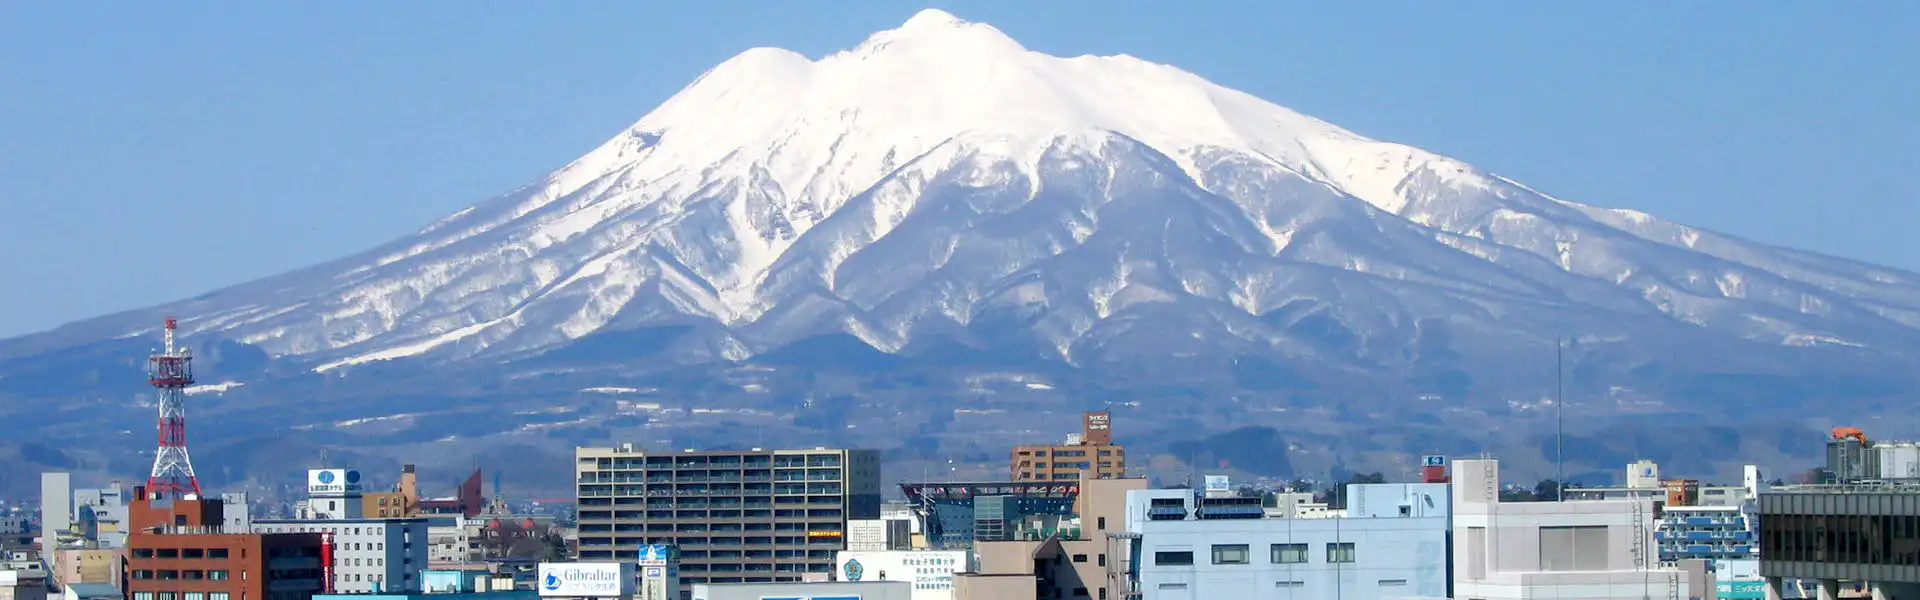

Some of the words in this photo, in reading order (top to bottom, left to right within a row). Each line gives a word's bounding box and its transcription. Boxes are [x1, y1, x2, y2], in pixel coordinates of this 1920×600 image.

[564, 568, 617, 581] Gibraltar
[567, 582, 617, 592] ブラルタ生命
